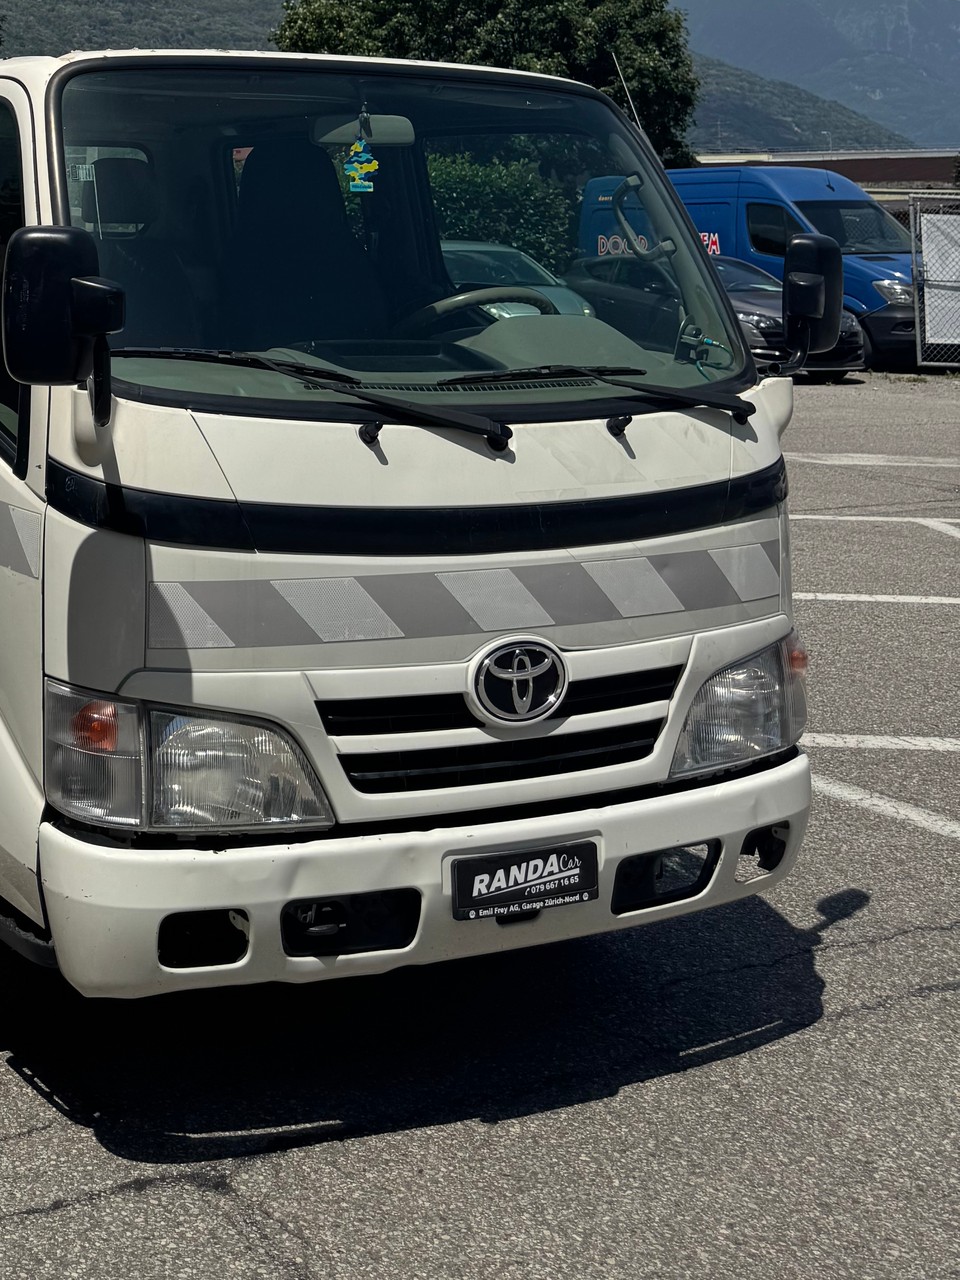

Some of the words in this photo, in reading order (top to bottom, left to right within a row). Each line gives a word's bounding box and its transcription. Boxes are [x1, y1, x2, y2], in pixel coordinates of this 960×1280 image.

[472, 853, 560, 897] RANDA
[559, 854, 582, 871] Car
[530, 883, 545, 894] 079
[545, 880, 559, 890] 667
[560, 878, 569, 887] 16
[569, 875, 579, 884] 65
[478, 907, 494, 917] Emil
[494, 906, 508, 915] Frey
[509, 904, 521, 912] AG,
[521, 901, 544, 911] Garage
[544, 893, 580, 907] Zürich-Nord
